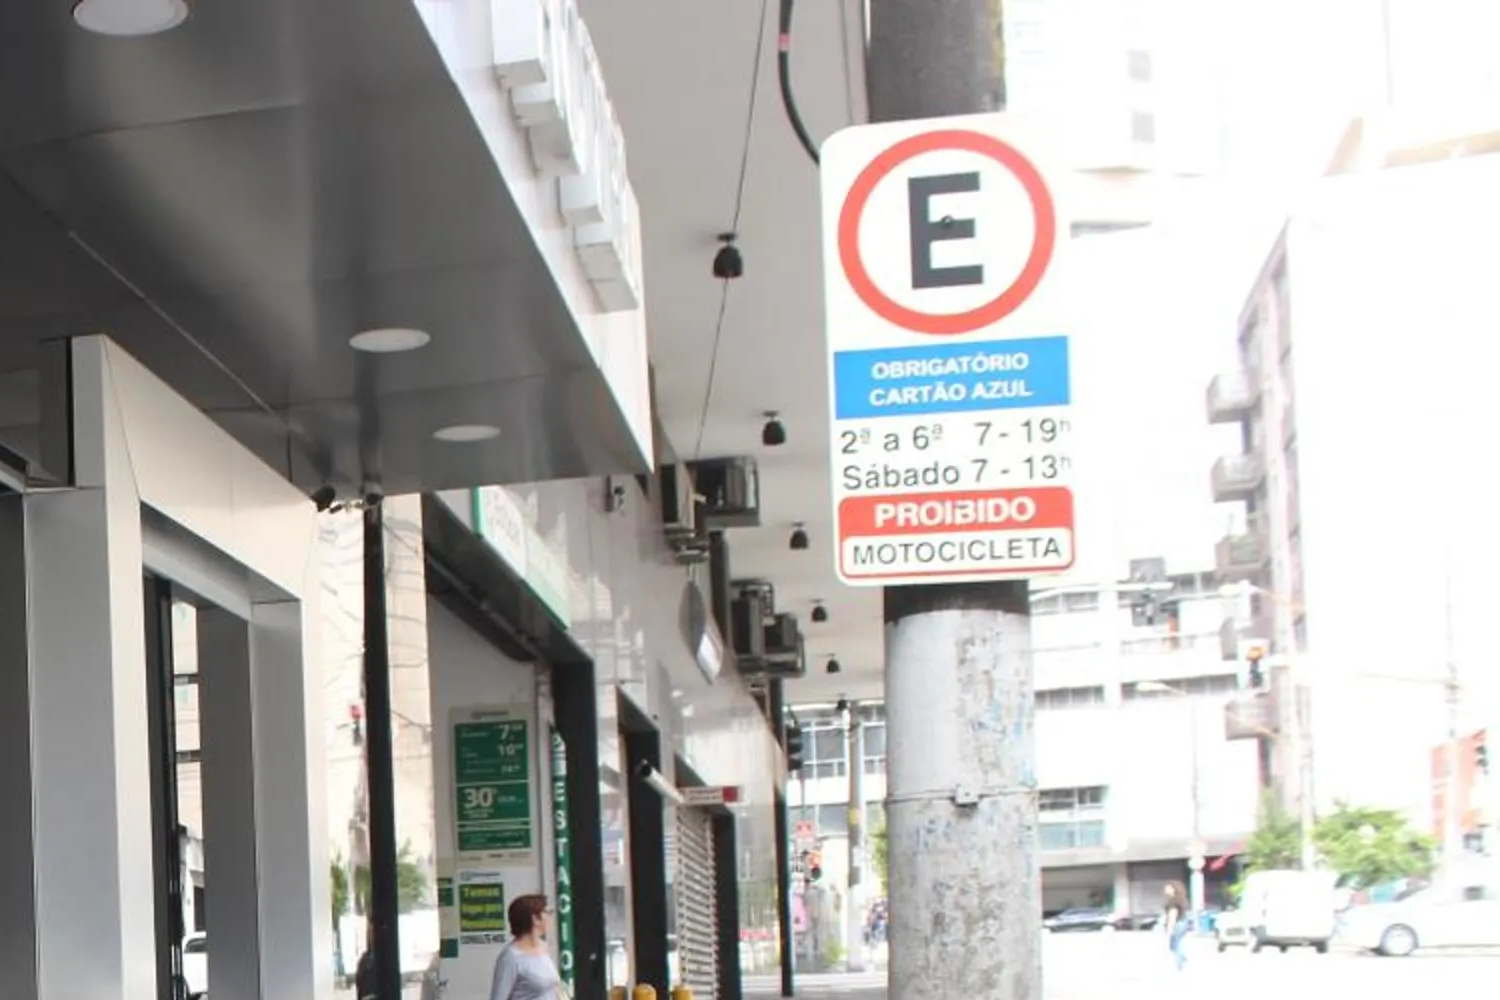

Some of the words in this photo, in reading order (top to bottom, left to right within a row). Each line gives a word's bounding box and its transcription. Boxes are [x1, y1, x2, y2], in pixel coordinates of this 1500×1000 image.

[907, 171, 984, 290] E
[870, 351, 1029, 380] OBRIGATÓRIO
[868, 381, 966, 407] CARTÃO
[971, 379, 1034, 400] AZUL
[883, 431, 900, 453] a
[842, 461, 960, 491] Sábado
[971, 458, 988, 483] 7
[874, 495, 1037, 529] PROIBIDO
[852, 536, 1062, 566] MOTOCICLETA
